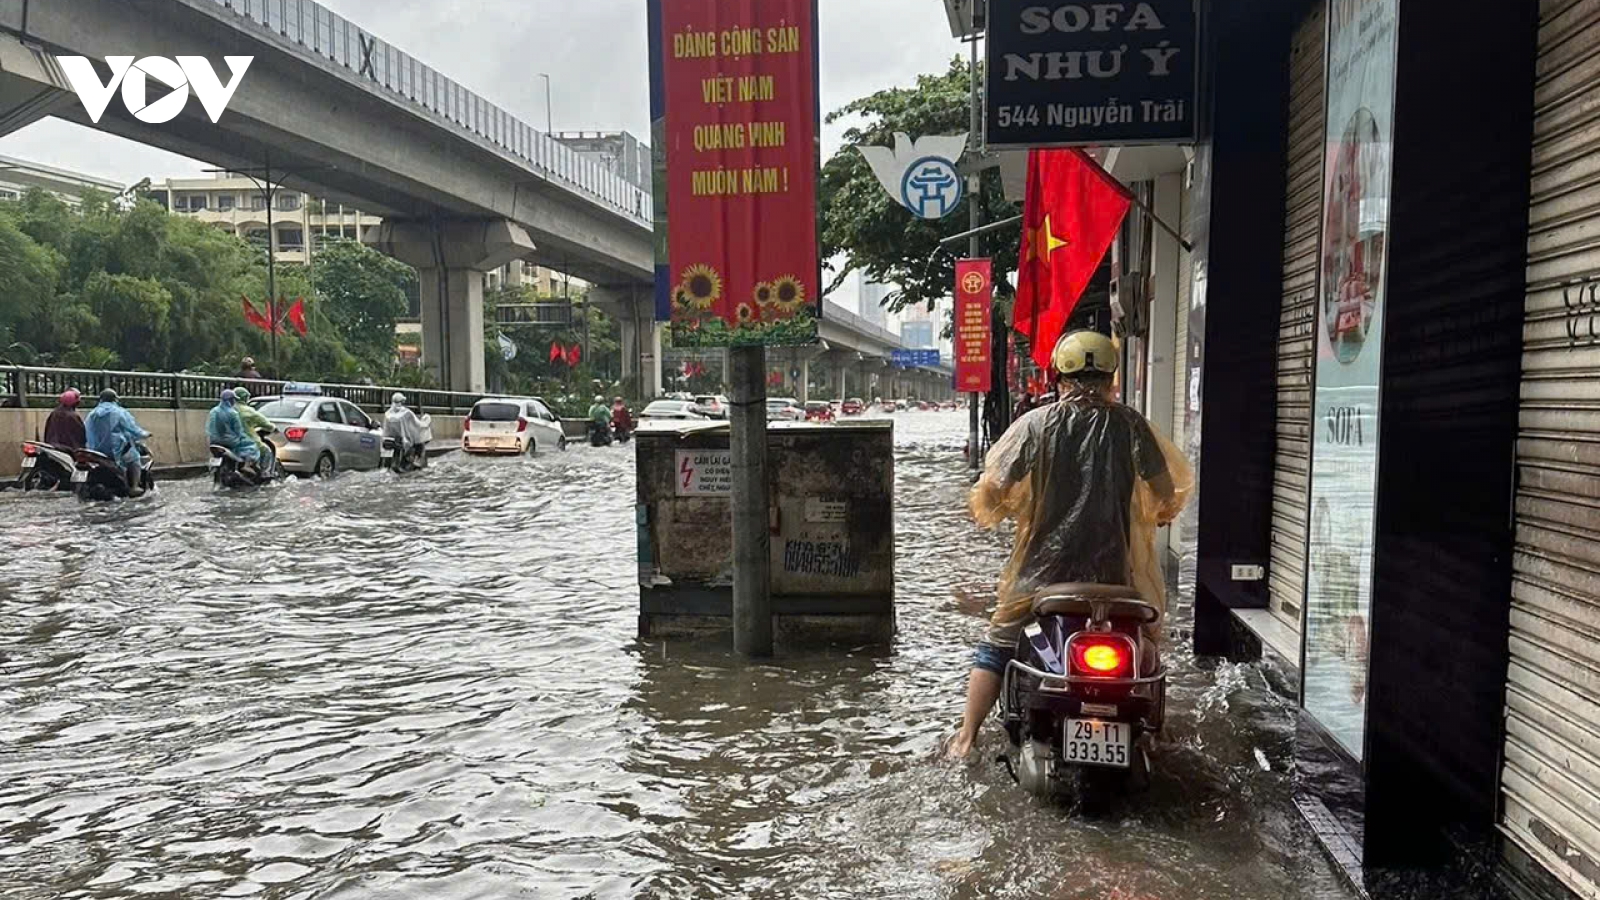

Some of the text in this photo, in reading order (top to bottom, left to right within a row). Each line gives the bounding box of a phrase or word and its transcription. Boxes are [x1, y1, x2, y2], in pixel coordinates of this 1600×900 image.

[1020, 3, 1165, 34] SOFA
[673, 18, 800, 61] ĐẢNG CỘNG SẢN
[1003, 41, 1180, 81] NHƯ Ý
[702, 73, 774, 108] VIỆT NAM
[998, 97, 1184, 128] 544 Nguyễn Trãi
[694, 121, 785, 152] QUANG VINH
[692, 165, 737, 195] MUÔN
[742, 164, 778, 193] NĂM
[1327, 406, 1362, 446] SOFA
[1074, 721, 1120, 743] 29-T1
[1069, 741, 1126, 764] 333.55
